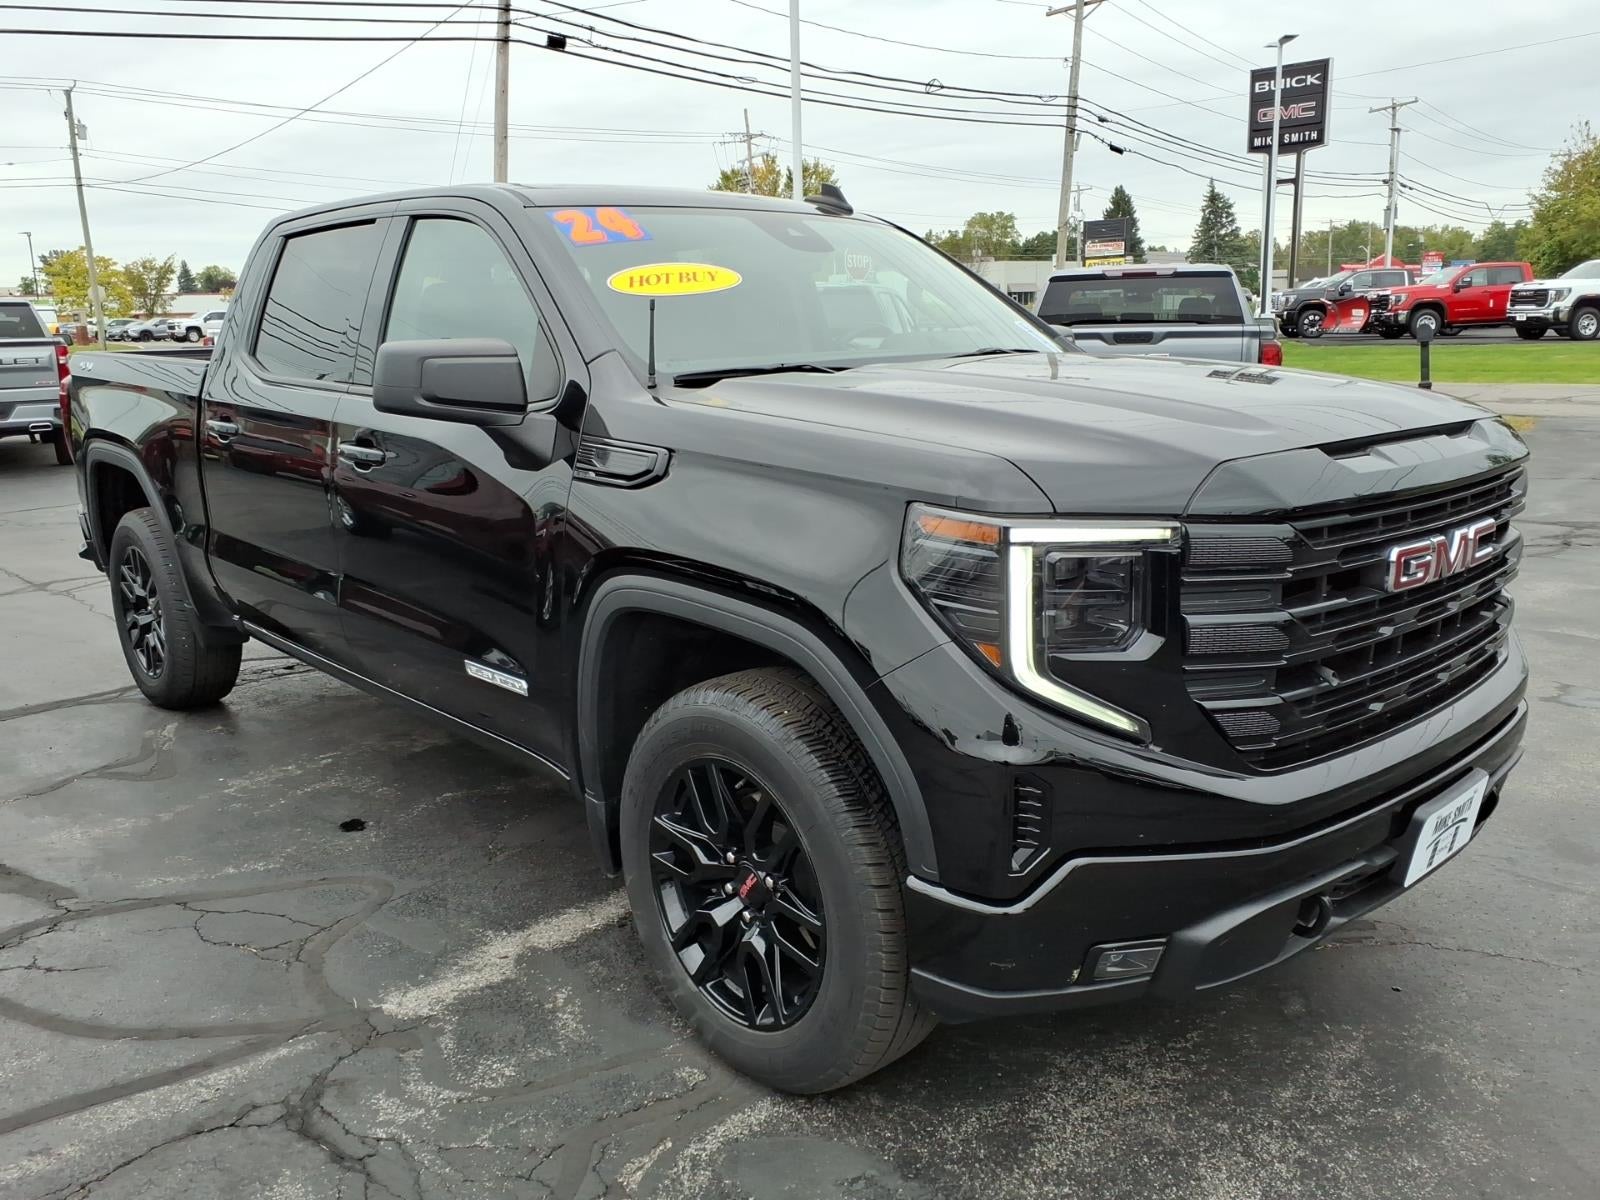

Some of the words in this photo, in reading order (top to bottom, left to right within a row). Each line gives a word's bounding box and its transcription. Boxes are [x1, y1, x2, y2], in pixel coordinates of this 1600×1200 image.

[1254, 72, 1322, 93] BUICK
[1257, 101, 1316, 123] GMC
[1253, 136, 1273, 147] MIK
[1283, 130, 1318, 143] SMITH
[552, 207, 644, 244] 24
[628, 273, 674, 288] HOT
[678, 271, 718, 283] BUY
[1387, 517, 1496, 592] GMC
